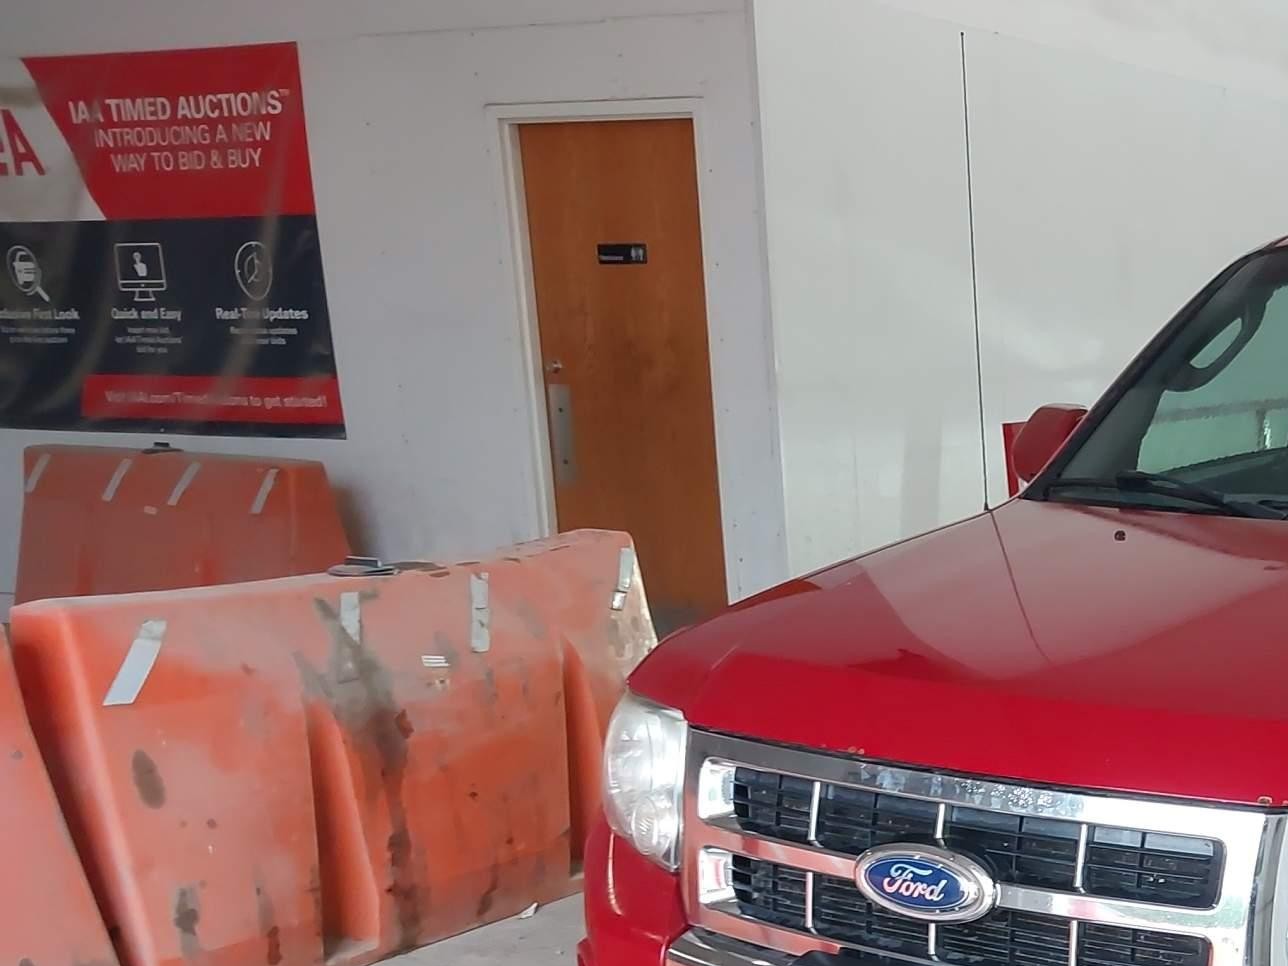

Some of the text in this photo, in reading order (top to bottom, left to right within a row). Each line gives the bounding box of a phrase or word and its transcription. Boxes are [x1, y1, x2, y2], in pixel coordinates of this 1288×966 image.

[106, 97, 171, 122] TIMED
[95, 121, 272, 148] INTRODUCING A NEW
[110, 148, 262, 173] WAY TO BID & BUY
[883, 863, 948, 901] Ford
